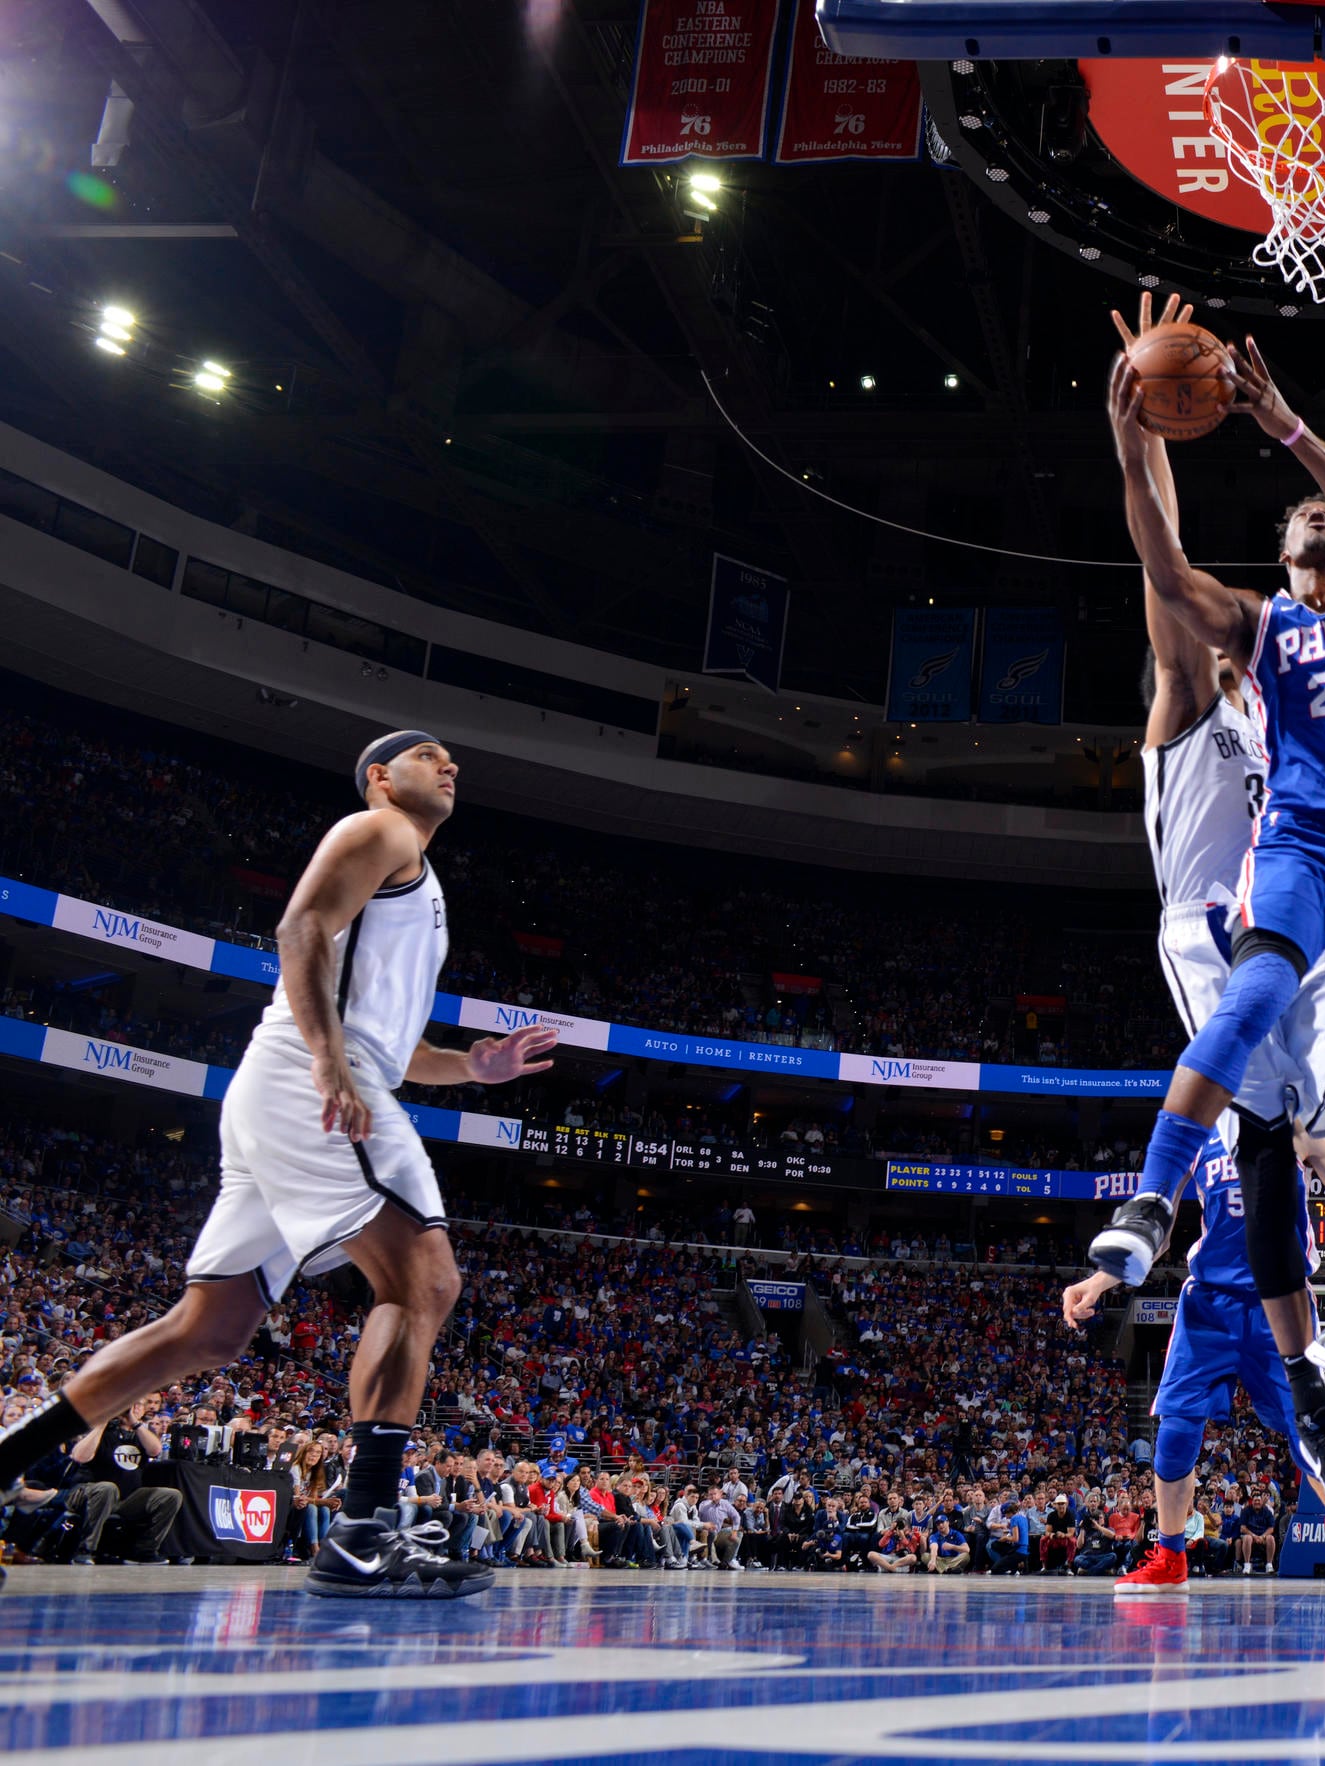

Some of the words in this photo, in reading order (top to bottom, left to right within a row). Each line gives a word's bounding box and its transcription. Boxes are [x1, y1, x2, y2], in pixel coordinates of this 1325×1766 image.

[696, 1, 725, 15] NBA
[676, 16, 742, 32] EASTERN
[662, 32, 753, 49] CONFERENCE
[664, 49, 747, 67] CHAMPIONS
[671, 78, 731, 96] 2000-01
[823, 79, 888, 94] 1982-83
[680, 113, 712, 135] 76
[833, 113, 867, 135] 76
[640, 140, 713, 154] Philadelphia
[716, 142, 747, 152] 76ers
[792, 141, 868, 152] Philadelphia
[870, 141, 903, 150] 76ers
[92, 909, 140, 941] NJM
[140, 923, 178, 941] Insurance
[138, 933, 163, 949] Group
[540, 1015, 575, 1028] Insurance
[84, 1041, 133, 1071] NJM
[645, 1038, 678, 1053] AUTO
[695, 1045, 733, 1059] HOME
[749, 1051, 804, 1066] RENTERS
[132, 1052, 171, 1070] Insurance
[911, 1063, 946, 1073] Insurance
[131, 1063, 156, 1077] Group
[871, 1060, 912, 1080] NJM
[911, 1071, 933, 1081] Group
[1021, 1074, 1040, 1084] This
[1061, 1077, 1079, 1087] just
[526, 1128, 547, 1141] PHI
[555, 1133, 569, 1143] 21
[575, 1136, 589, 1146] 13
[522, 1140, 549, 1153] BKN
[554, 1145, 568, 1155] 12
[635, 1141, 668, 1156] 8:54
[676, 1145, 694, 1155] ORL
[642, 1156, 657, 1165] PM
[731, 1151, 745, 1159] SA
[786, 1156, 806, 1165] OKC
[675, 1158, 694, 1168] TOR
[730, 1163, 750, 1173] DEN
[758, 1160, 777, 1169] 9:30
[807, 1165, 832, 1174] 10:30
[785, 1169, 804, 1178] POR
[890, 1165, 930, 1176] PLAYER
[934, 1168, 946, 1176] 23
[978, 1171, 990, 1179] 51
[993, 1171, 1005, 1180] 12
[1012, 1173, 1038, 1181] FOULS
[1044, 1173, 1051, 1183] 1
[891, 1178, 929, 1188] POINTS
[1044, 1185, 1051, 1195] 5
[753, 1284, 798, 1297] GEICO
[783, 1298, 802, 1309] 108
[1136, 1312, 1155, 1322] 108
[215, 1498, 235, 1530] NBA
